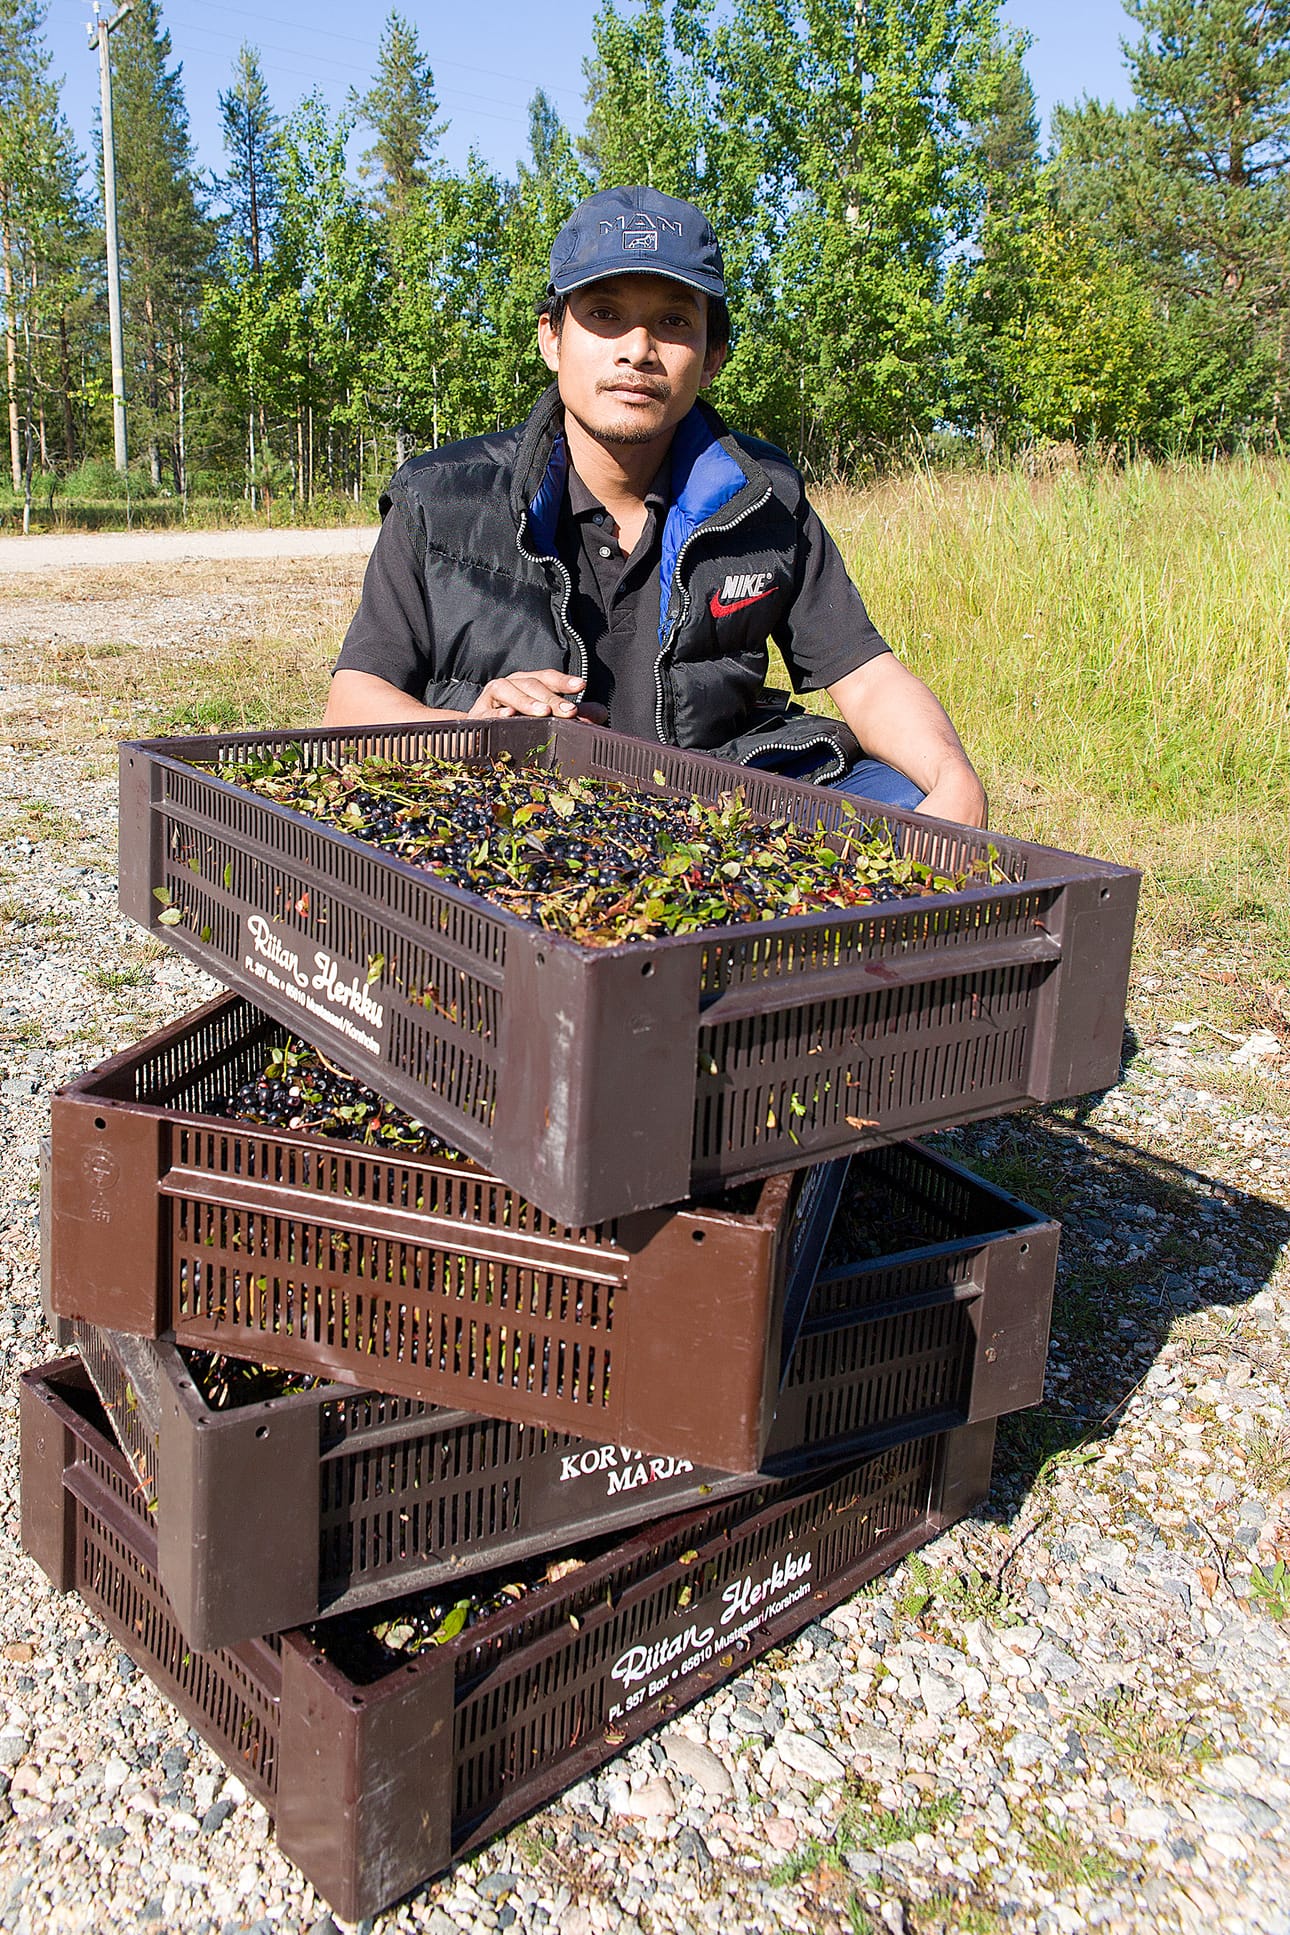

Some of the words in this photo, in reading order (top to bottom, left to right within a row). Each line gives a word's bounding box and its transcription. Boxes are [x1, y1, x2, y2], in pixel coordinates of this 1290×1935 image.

[600, 213, 682, 236] MAN
[247, 915, 309, 988] Riitan
[311, 951, 383, 1029] Herkku
[606, 1456, 694, 1496] MARJA
[611, 1624, 715, 1689] Riitan
[720, 1552, 812, 1625] Herkku
[608, 1703, 624, 1722] PL
[648, 1674, 669, 1697] Box
